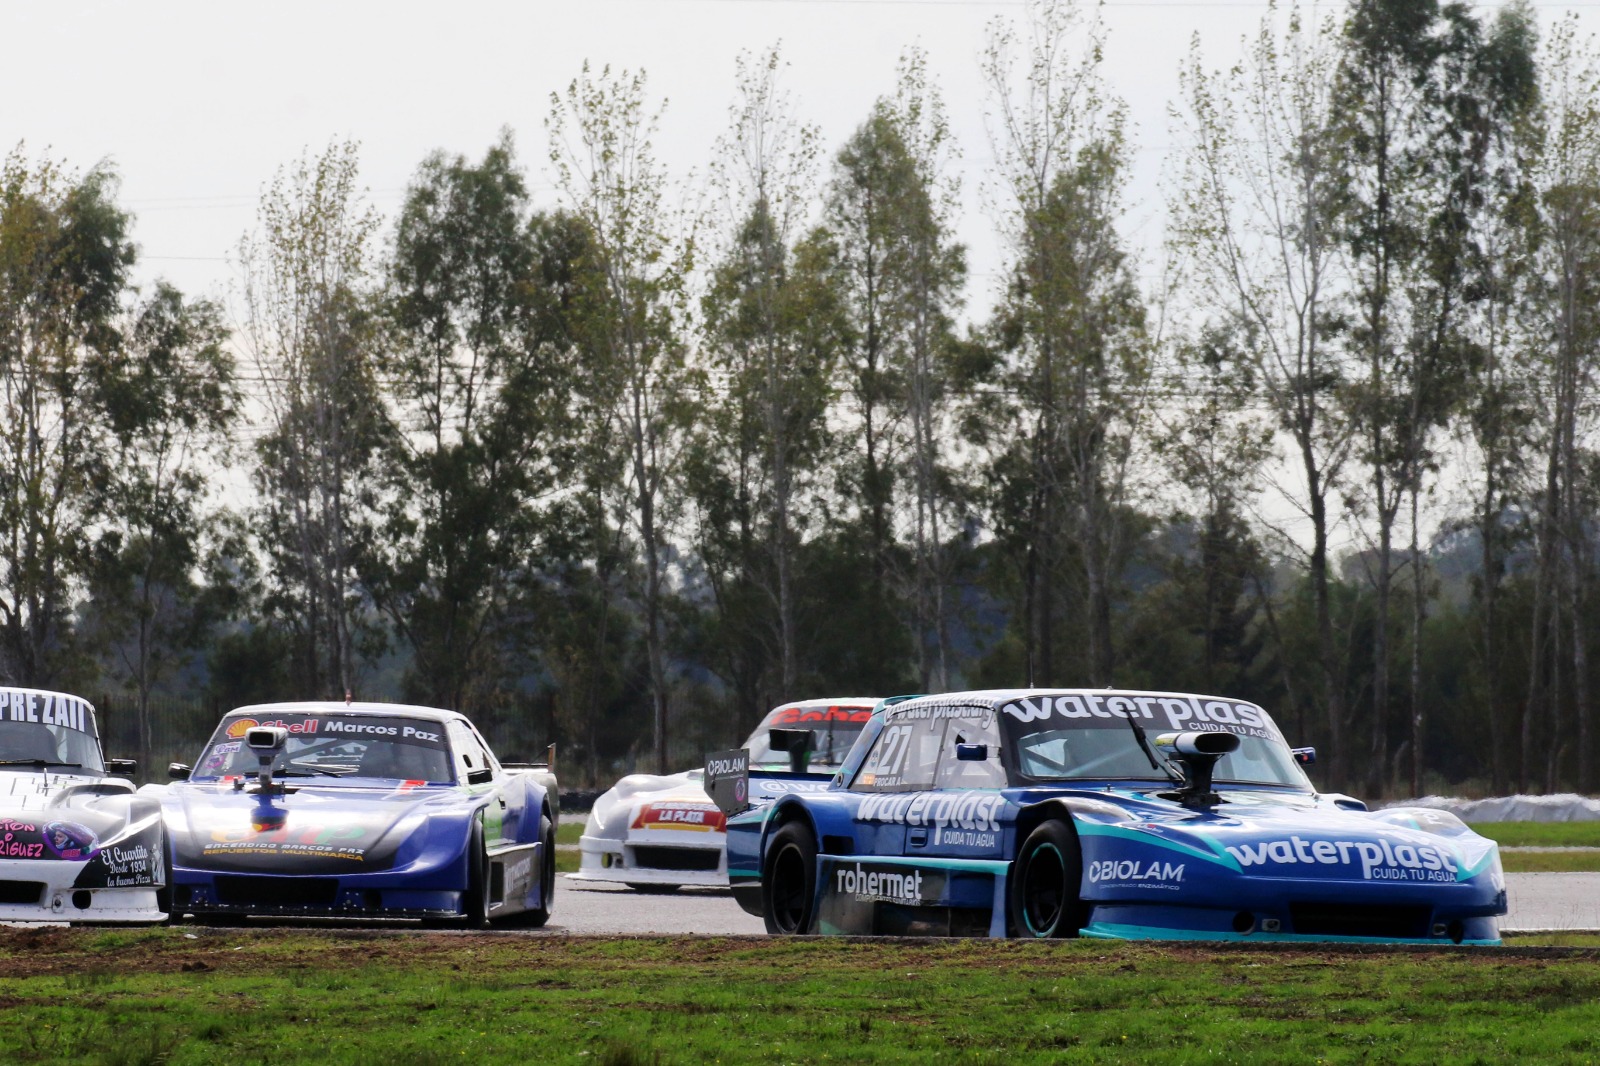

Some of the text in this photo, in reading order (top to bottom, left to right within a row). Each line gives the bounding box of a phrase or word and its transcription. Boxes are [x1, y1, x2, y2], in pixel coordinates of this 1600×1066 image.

[325, 721, 397, 735] Marcos
[402, 726, 439, 742] Paz
[1189, 722, 1227, 734] CUIDA
[1230, 725, 1247, 735] TU
[876, 725, 913, 774] 27
[658, 810, 705, 823] LA PLATA
[857, 790, 1004, 845] waterplast
[944, 831, 995, 848] CUIDA TU AGUA
[281, 844, 332, 852] MARCOS
[338, 847, 365, 855] PAZ
[281, 850, 364, 861] MULTIMARCA
[1225, 836, 1458, 879] waterplast
[110, 860, 147, 873] Desde 1934
[837, 862, 922, 899] rohermet
[1373, 868, 1458, 882] CUIDA TU AGUA
